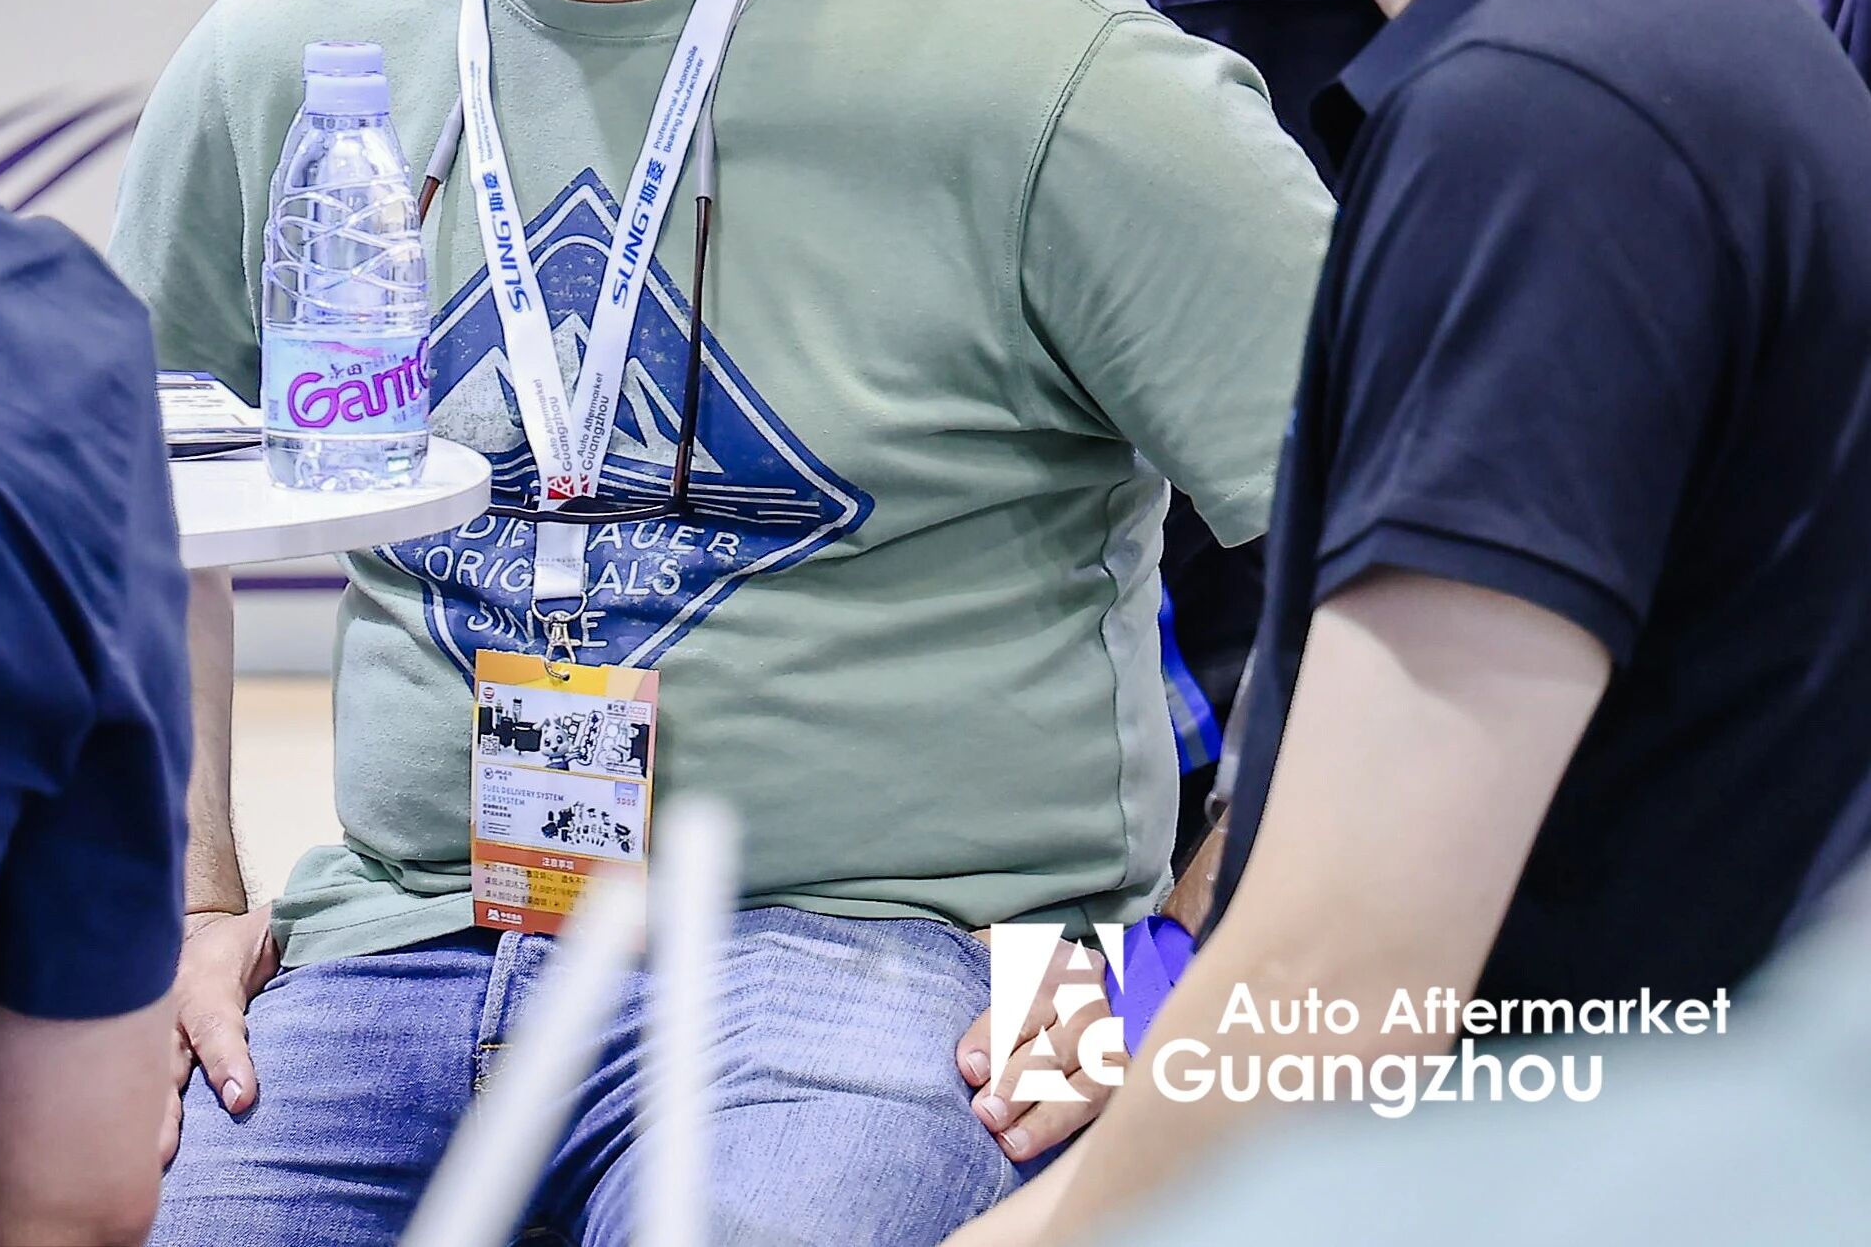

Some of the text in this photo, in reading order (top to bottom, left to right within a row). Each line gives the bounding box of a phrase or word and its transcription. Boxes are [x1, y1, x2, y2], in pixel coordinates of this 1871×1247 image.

[653, 45, 698, 150] Professional Automobile
[663, 58, 704, 153] Bearing Manufacturer
[492, 218, 532, 312] SLING
[613, 209, 650, 308] SLING
[549, 396, 573, 471] Guangzhou
[578, 433, 590, 459] Auto
[585, 372, 603, 432] Aftermarket
[582, 396, 609, 471] Guangzhou
[424, 545, 682, 597] ORIGALS
[457, 517, 741, 556] DIE AUER
[467, 602, 608, 648] SINE
[536, 791, 564, 801] SYSTEM
